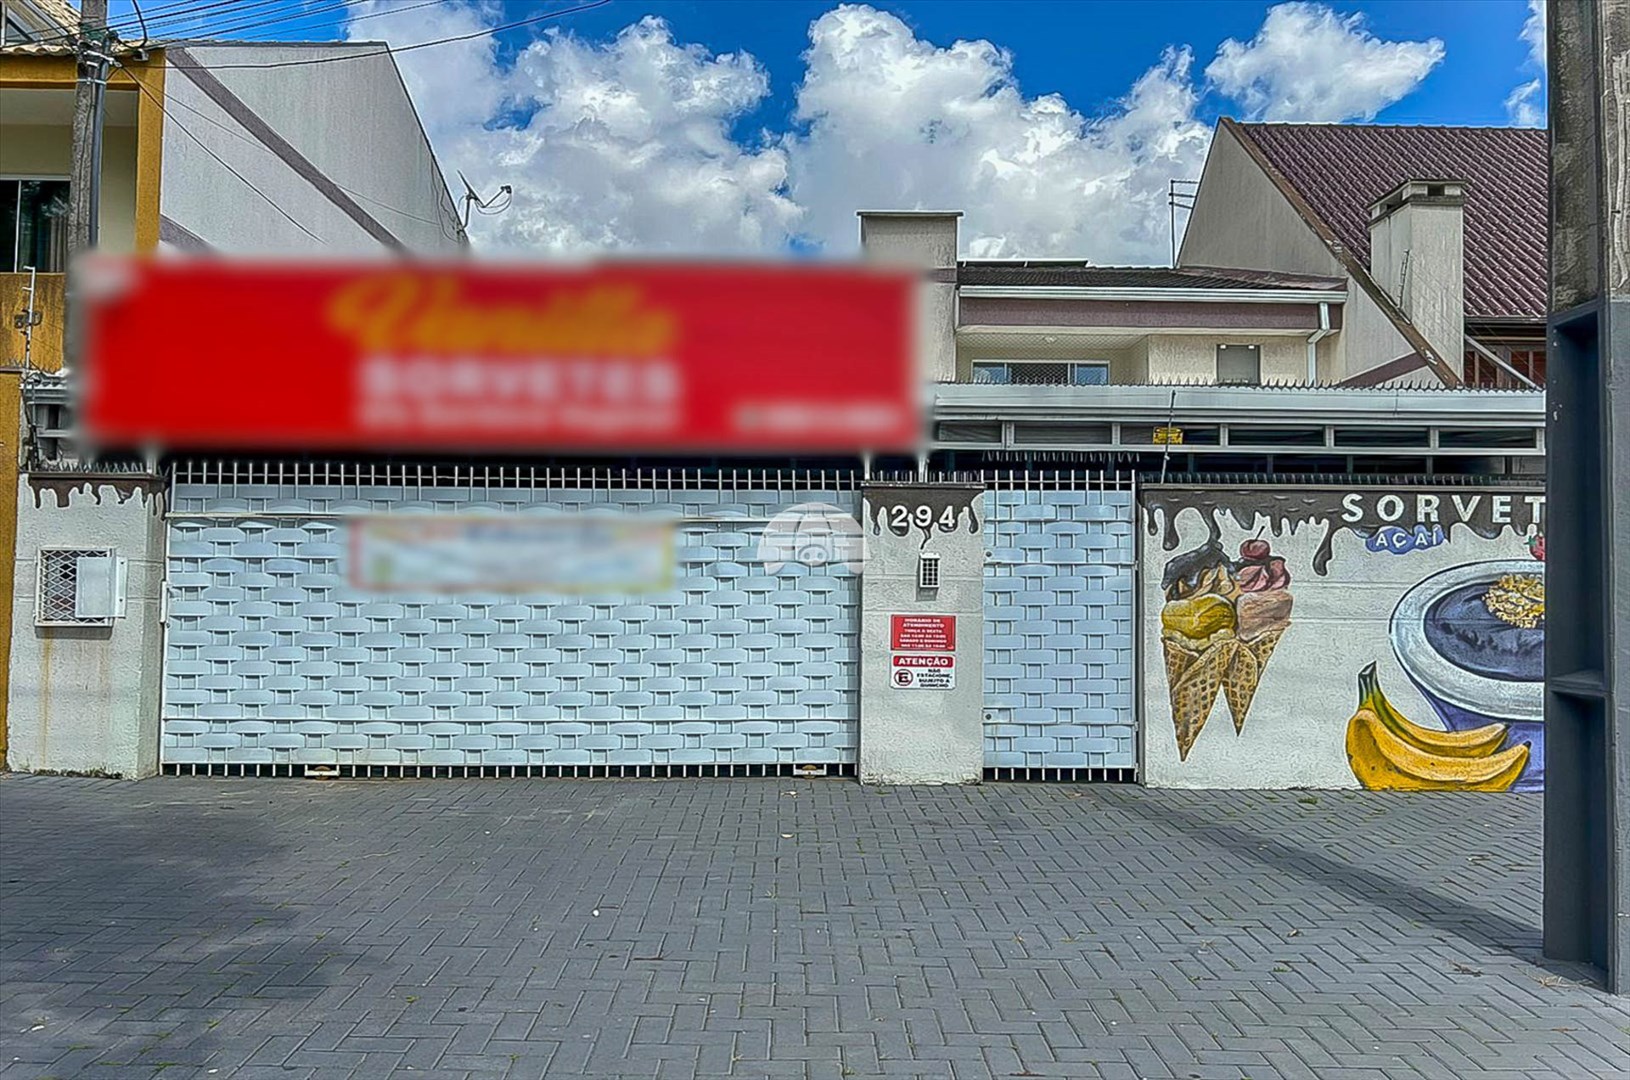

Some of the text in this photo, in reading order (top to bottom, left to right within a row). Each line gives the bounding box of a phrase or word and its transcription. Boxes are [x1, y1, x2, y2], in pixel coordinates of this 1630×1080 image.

[891, 505, 955, 527] 294
[1376, 525, 1440, 548] AÇAÍ
[898, 656, 949, 666] ATENÇÃO
